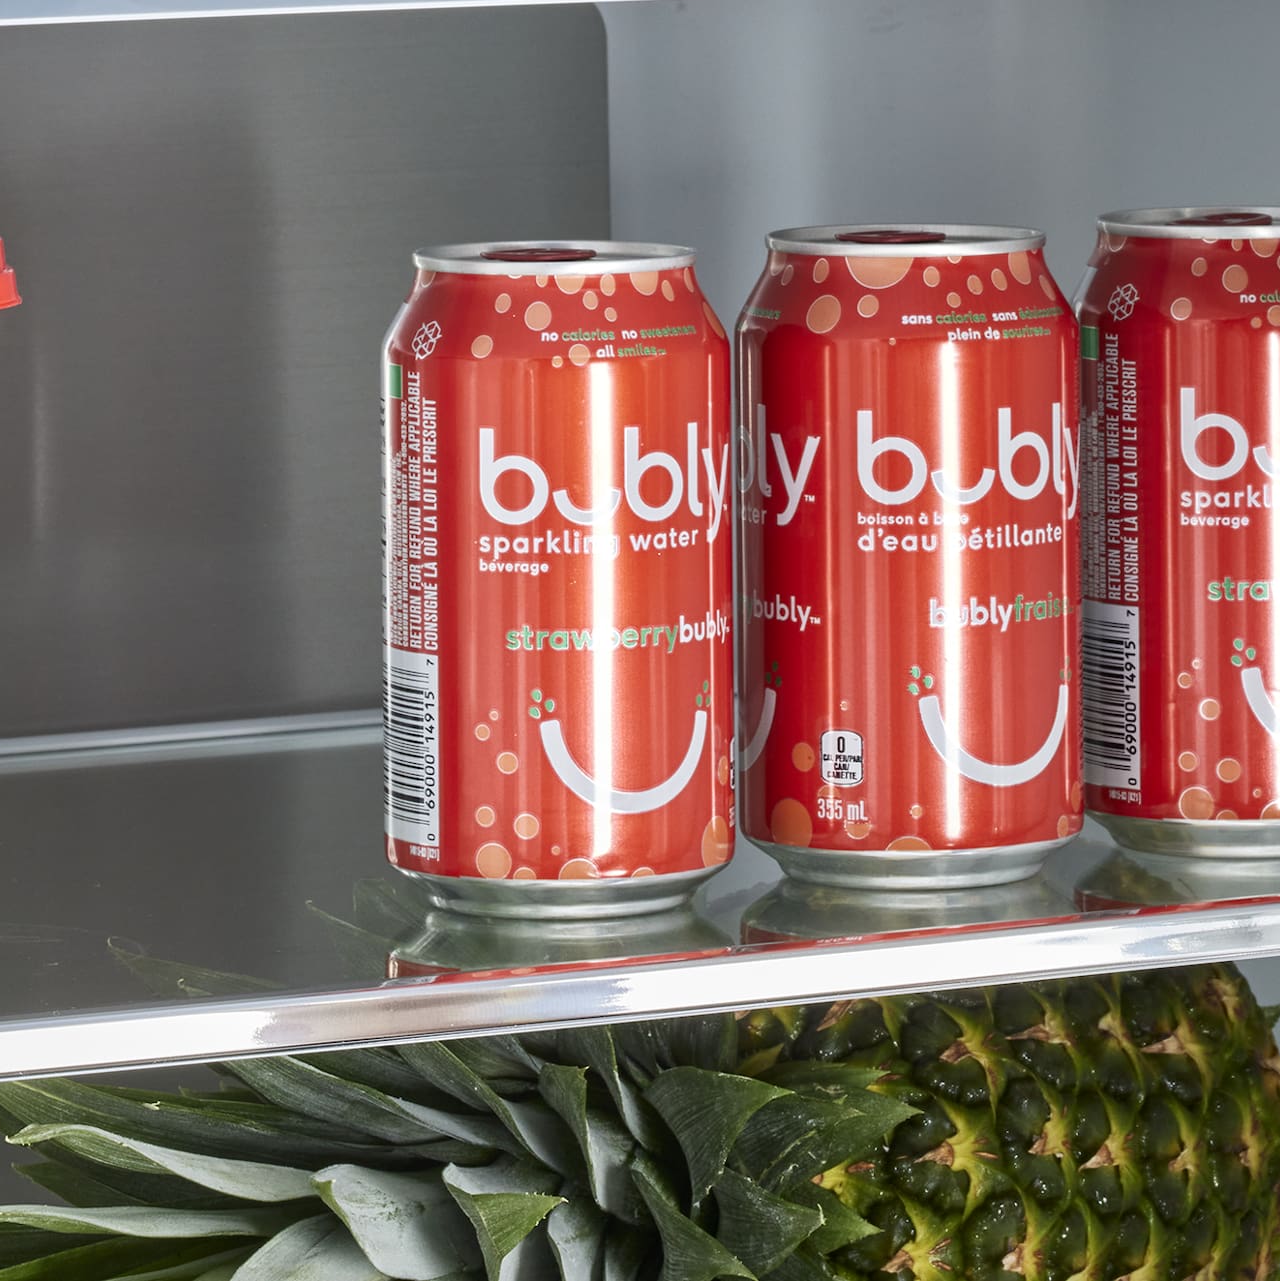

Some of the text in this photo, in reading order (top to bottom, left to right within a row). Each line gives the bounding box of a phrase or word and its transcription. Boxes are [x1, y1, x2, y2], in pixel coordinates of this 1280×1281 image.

[1239, 294, 1256, 304] no
[901, 314, 933, 325] sans
[992, 310, 1018, 322] sans
[541, 326, 638, 342] no calories no
[947, 326, 1000, 342] plein de
[596, 344, 615, 358] all
[856, 402, 1081, 520] bubly
[1105, 333, 1121, 600] RETURN FOR REFUND WHERE APPLICABLE
[479, 421, 730, 544] bubly
[1120, 357, 1139, 602] CONSIGNÉ LÀ OÙ LA LOI LE PRESCRIT
[407, 371, 422, 649] RETURN FOR REFUND WHERE APPLICABLE
[857, 512, 913, 525] boisson
[1180, 513, 1250, 529] beverage
[421, 397, 439, 651] CONSIGNÉ LÀ OÙ LA LOI LE PRESCRIT
[630, 526, 698, 552] water
[857, 528, 937, 552] d'eau
[479, 559, 549, 576] beverage
[1124, 640, 1136, 756] 69000 14915
[424, 691, 435, 810] 69000 14915
[817, 799, 869, 821] 355 mL
